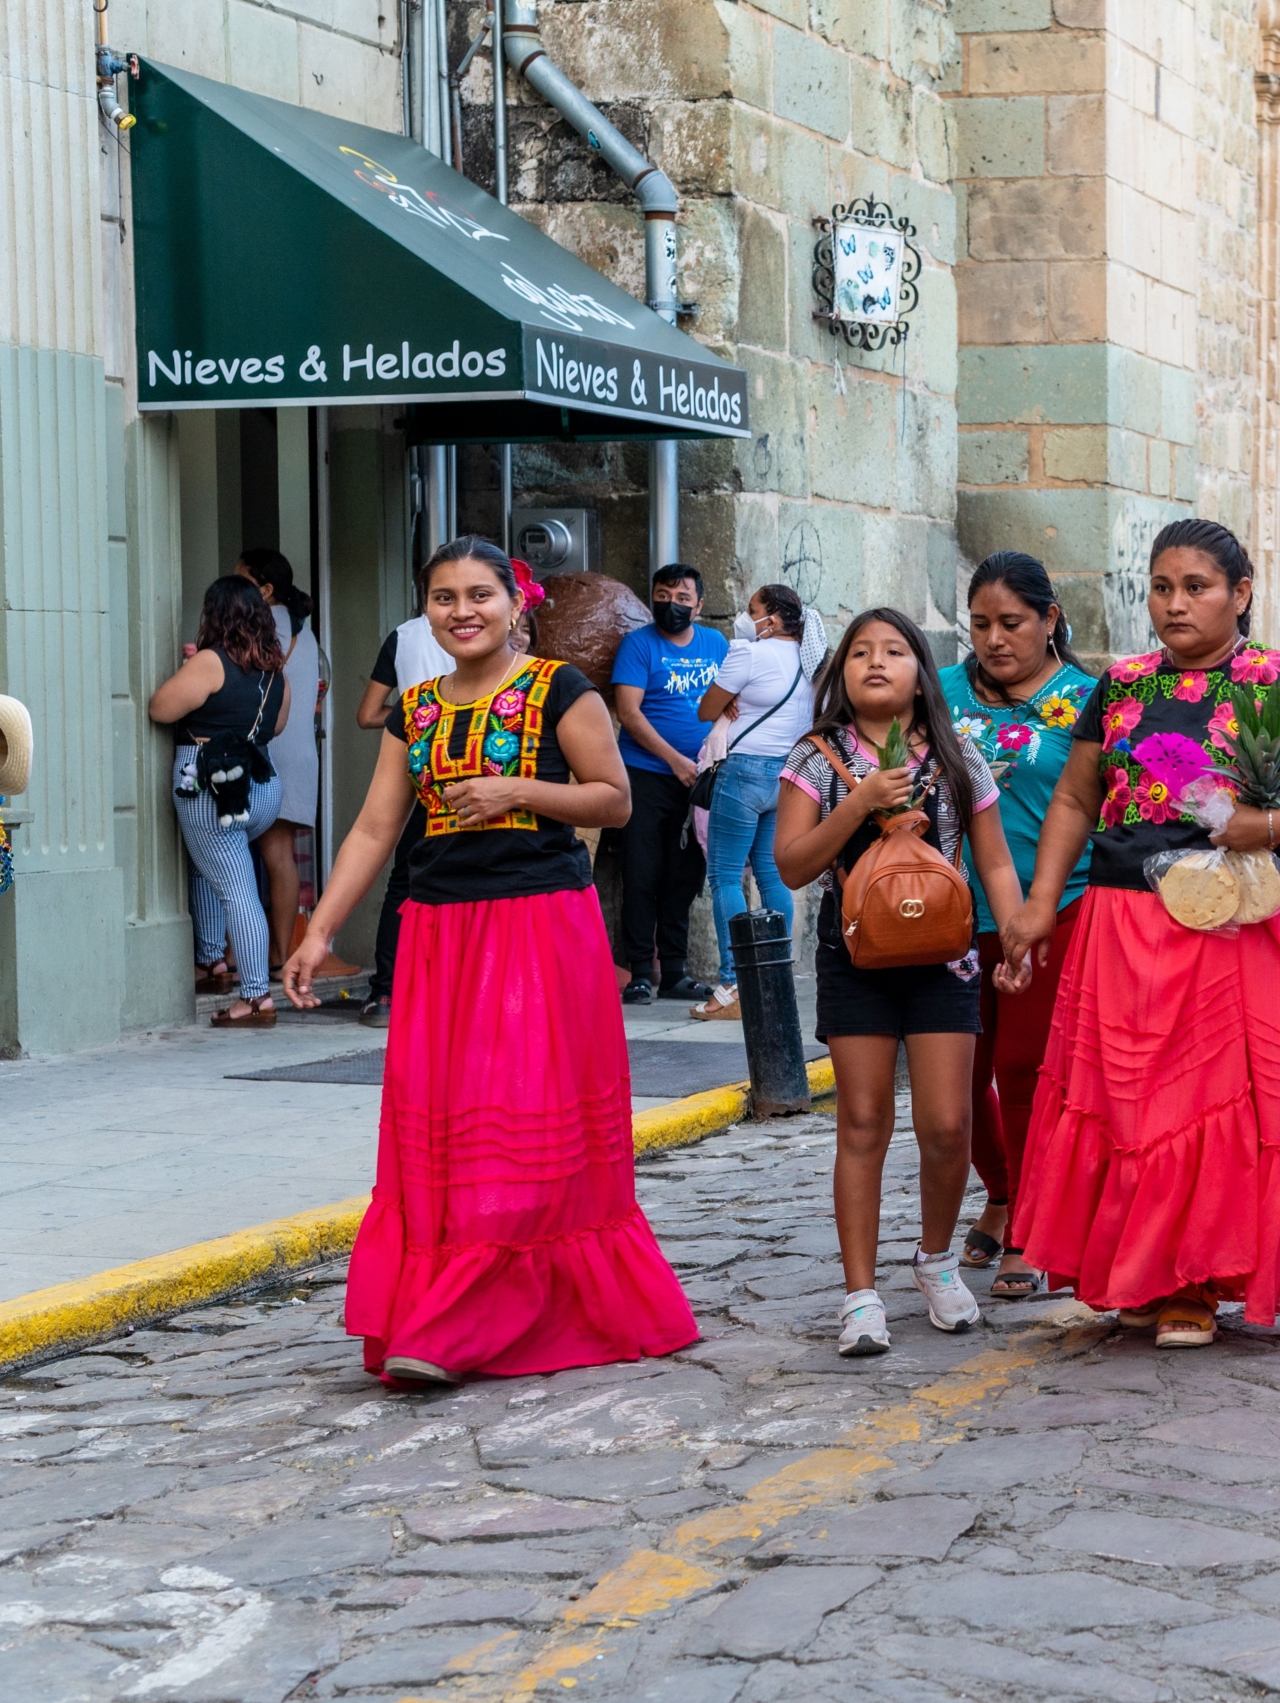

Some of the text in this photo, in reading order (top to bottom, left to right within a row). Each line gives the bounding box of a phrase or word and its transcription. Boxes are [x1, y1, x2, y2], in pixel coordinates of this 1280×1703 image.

[148, 339, 506, 387] Nieves & Helados
[536, 337, 742, 425] Nieves & Helados
